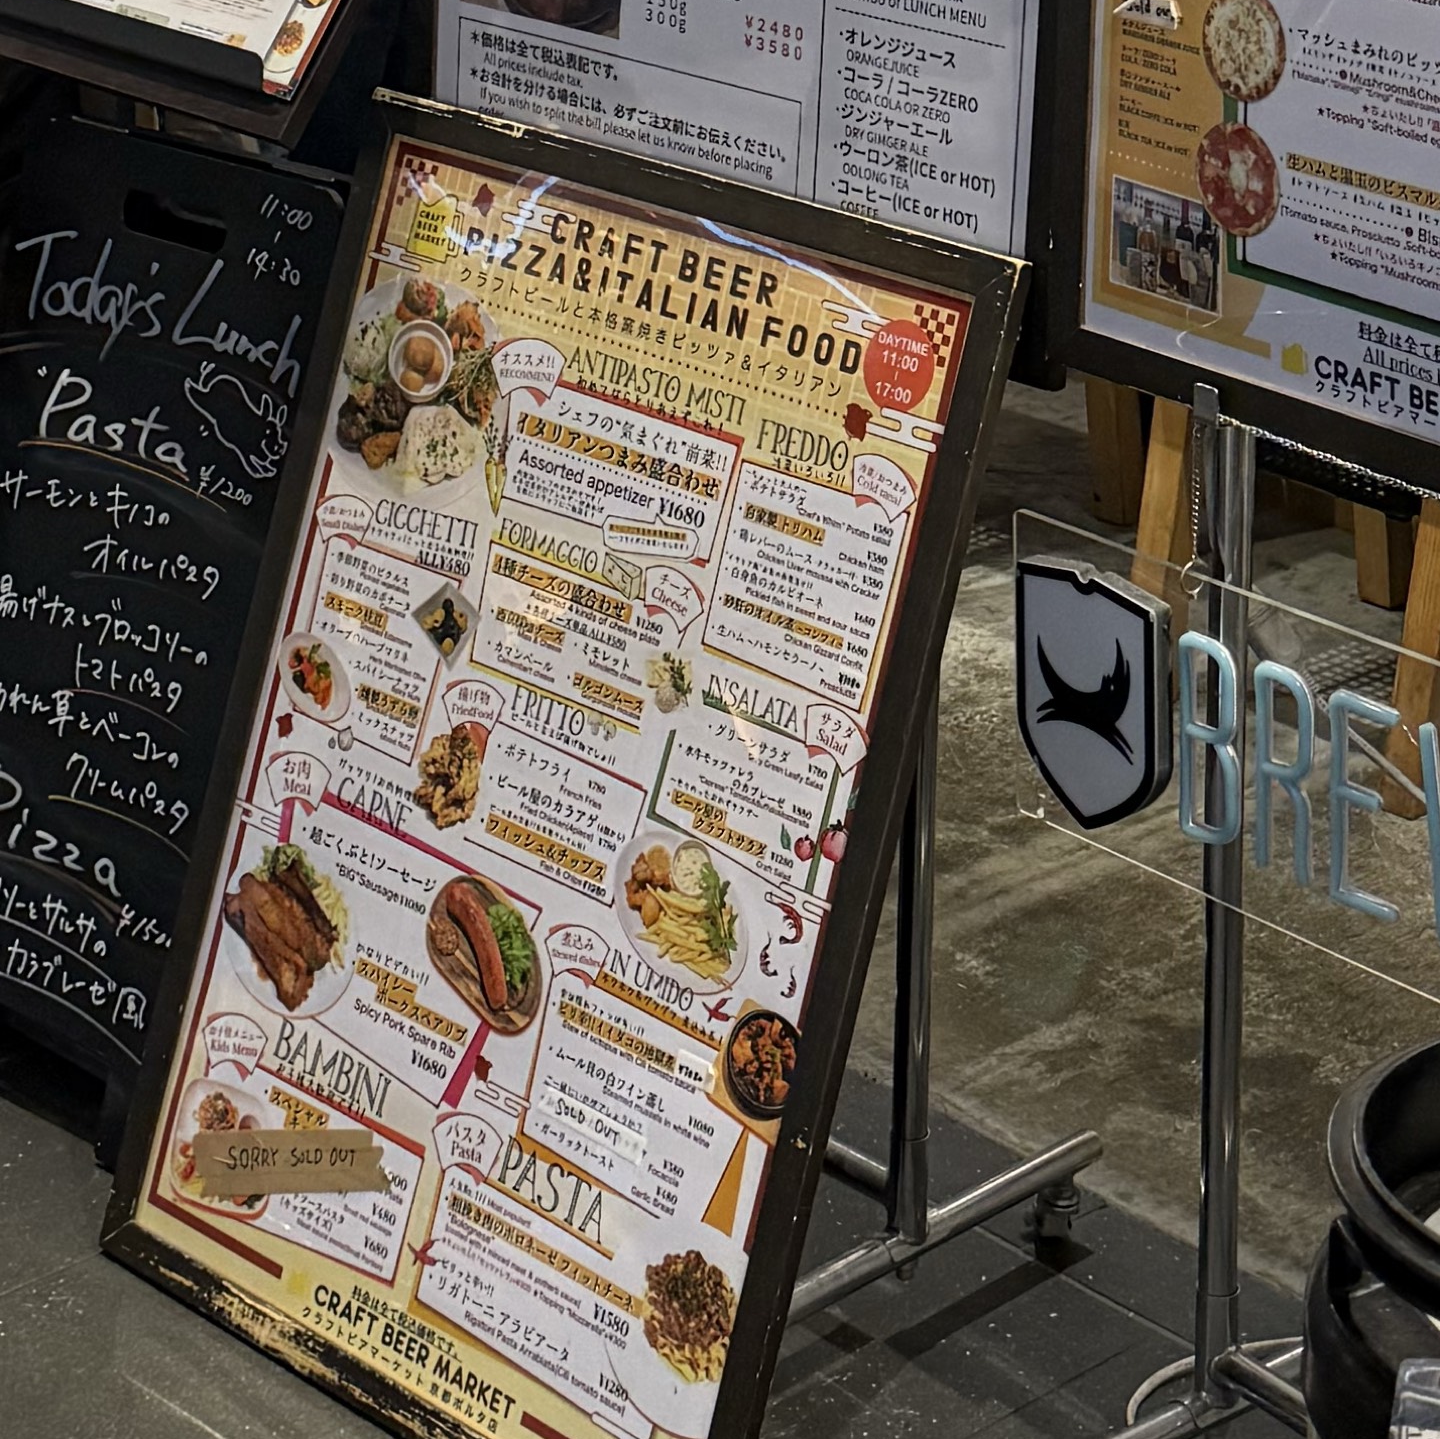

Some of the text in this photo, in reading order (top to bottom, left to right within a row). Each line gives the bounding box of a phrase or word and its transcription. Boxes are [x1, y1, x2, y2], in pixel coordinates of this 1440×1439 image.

[746, 15, 803, 41] ¥2480
[949, 10, 986, 28] MENU
[745, 34, 802, 60] ¥3580
[845, 27, 956, 69] オレンジジュース
[260, 193, 313, 229] 11:00
[247, 248, 300, 286] 14:30
[550, 213, 778, 308] CRAFT BEER
[172, 259, 302, 397] Lunch
[879, 331, 929, 357] DAYTIME
[761, 317, 860, 376] FOOD
[882, 350, 918, 372] 11:00
[566, 346, 747, 425] ANTIPASTO MISTI
[875, 381, 911, 404] 17:00
[1314, 356, 1400, 400] CRAFT
[757, 419, 849, 471] FREDDO
[519, 449, 705, 528] Assorted appetizer ¥1680
[498, 518, 598, 574] FORMAGGIO
[651, 588, 688, 616] Cheese
[660, 573, 691, 600] チーズ
[710, 674, 798, 732] INSALATA
[816, 729, 847, 755] Salad
[822, 712, 855, 738] サラダ
[355, 998, 380, 1018] Spicy
[273, 1018, 391, 1118] BAMBINI
[228, 1146, 356, 1171] SORRY SOLD OUT
[451, 1144, 482, 1164] Pasta
[498, 1134, 602, 1244] PASTA
[593, 1302, 629, 1337] ¥1580
[314, 1285, 516, 1419] CRAFT BEER MARKET
